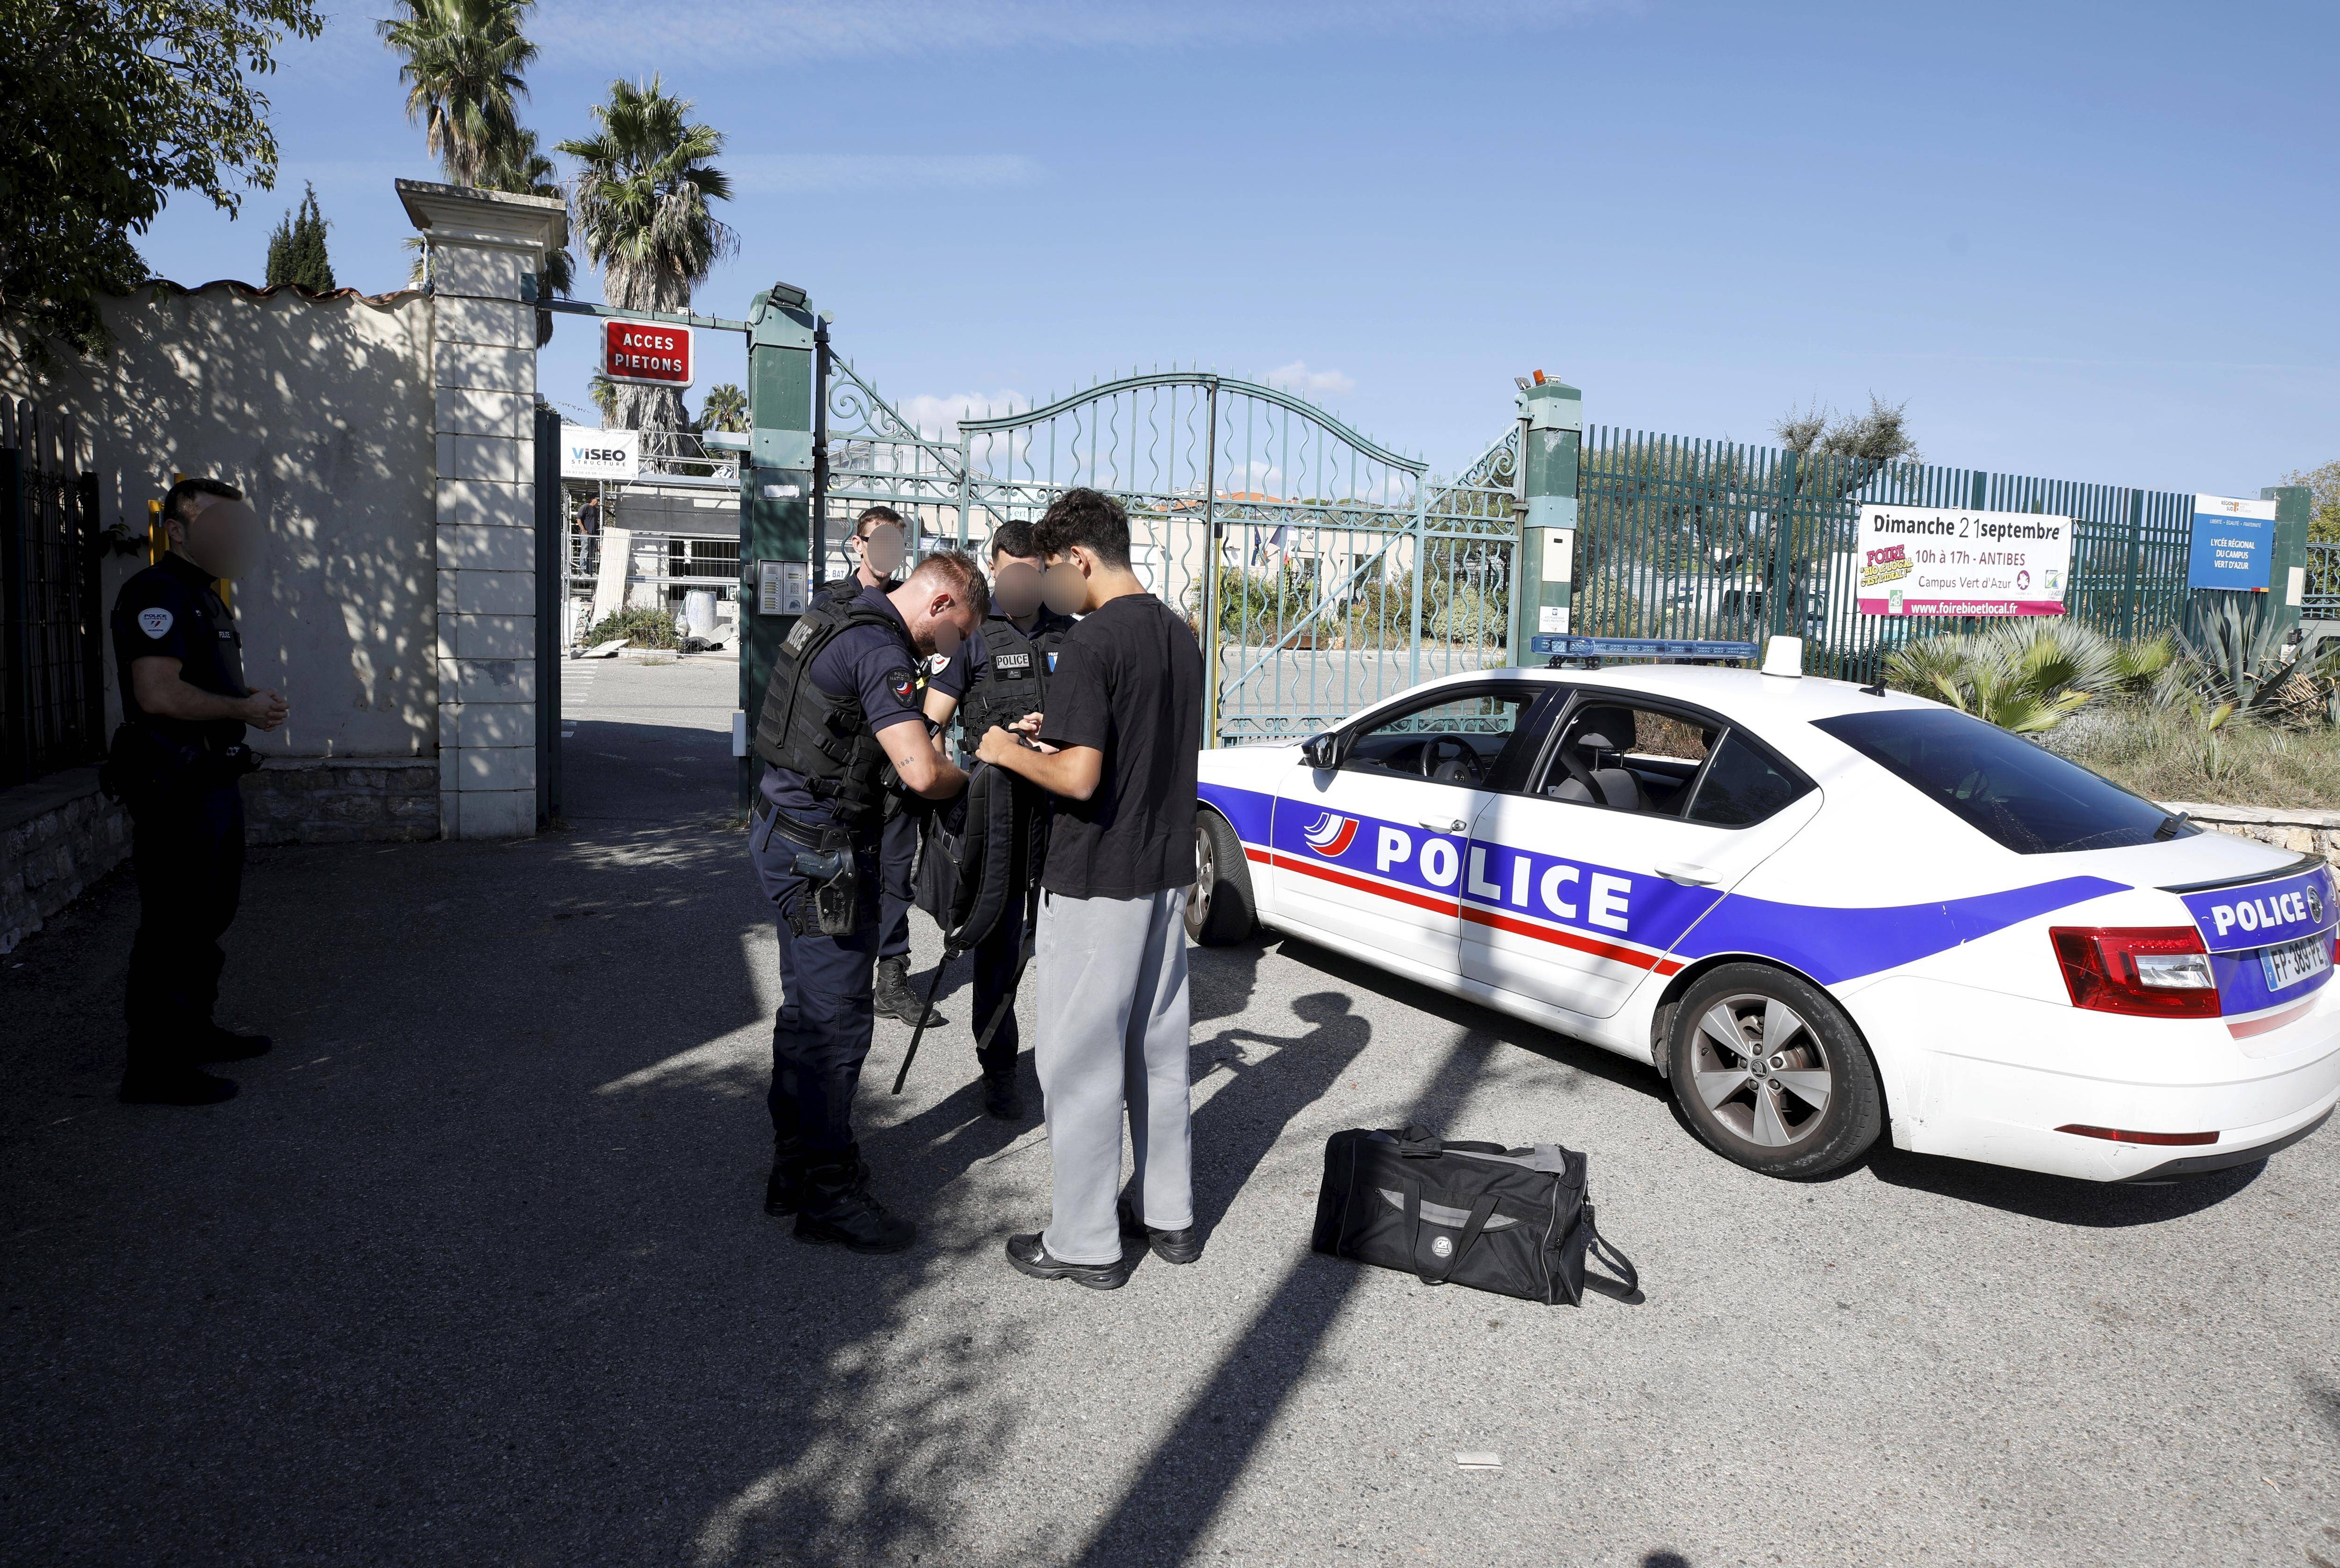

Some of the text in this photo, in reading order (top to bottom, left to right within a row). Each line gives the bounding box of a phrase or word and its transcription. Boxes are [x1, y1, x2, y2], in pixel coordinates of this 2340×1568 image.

[623, 333, 674, 350] ACCES
[615, 353, 682, 372] PIETONS
[1874, 514, 1955, 535] Dimanche
[2210, 537, 2255, 549] LYCÉE RÉGIONAL
[1866, 544, 1906, 567] FOIRE
[1916, 549, 1936, 563] 10h
[1939, 549, 1946, 564] à
[1950, 550, 1969, 564] 17h
[1979, 552, 2026, 566] ANTIBES
[2225, 550, 2249, 559] CAMPUS
[1887, 557, 1914, 572] LOCAL
[2214, 560, 2249, 569] VERT D'AZUR
[1918, 576, 2011, 590] Campus Vert d'Azur
[1911, 601, 2018, 614] www.foirebioetlocal.fr
[996, 655, 1029, 666] POLICE
[1376, 825, 1632, 932] POLICE
[2211, 891, 2307, 936] POLICE
[2271, 935, 2324, 982] FP-389-PE
